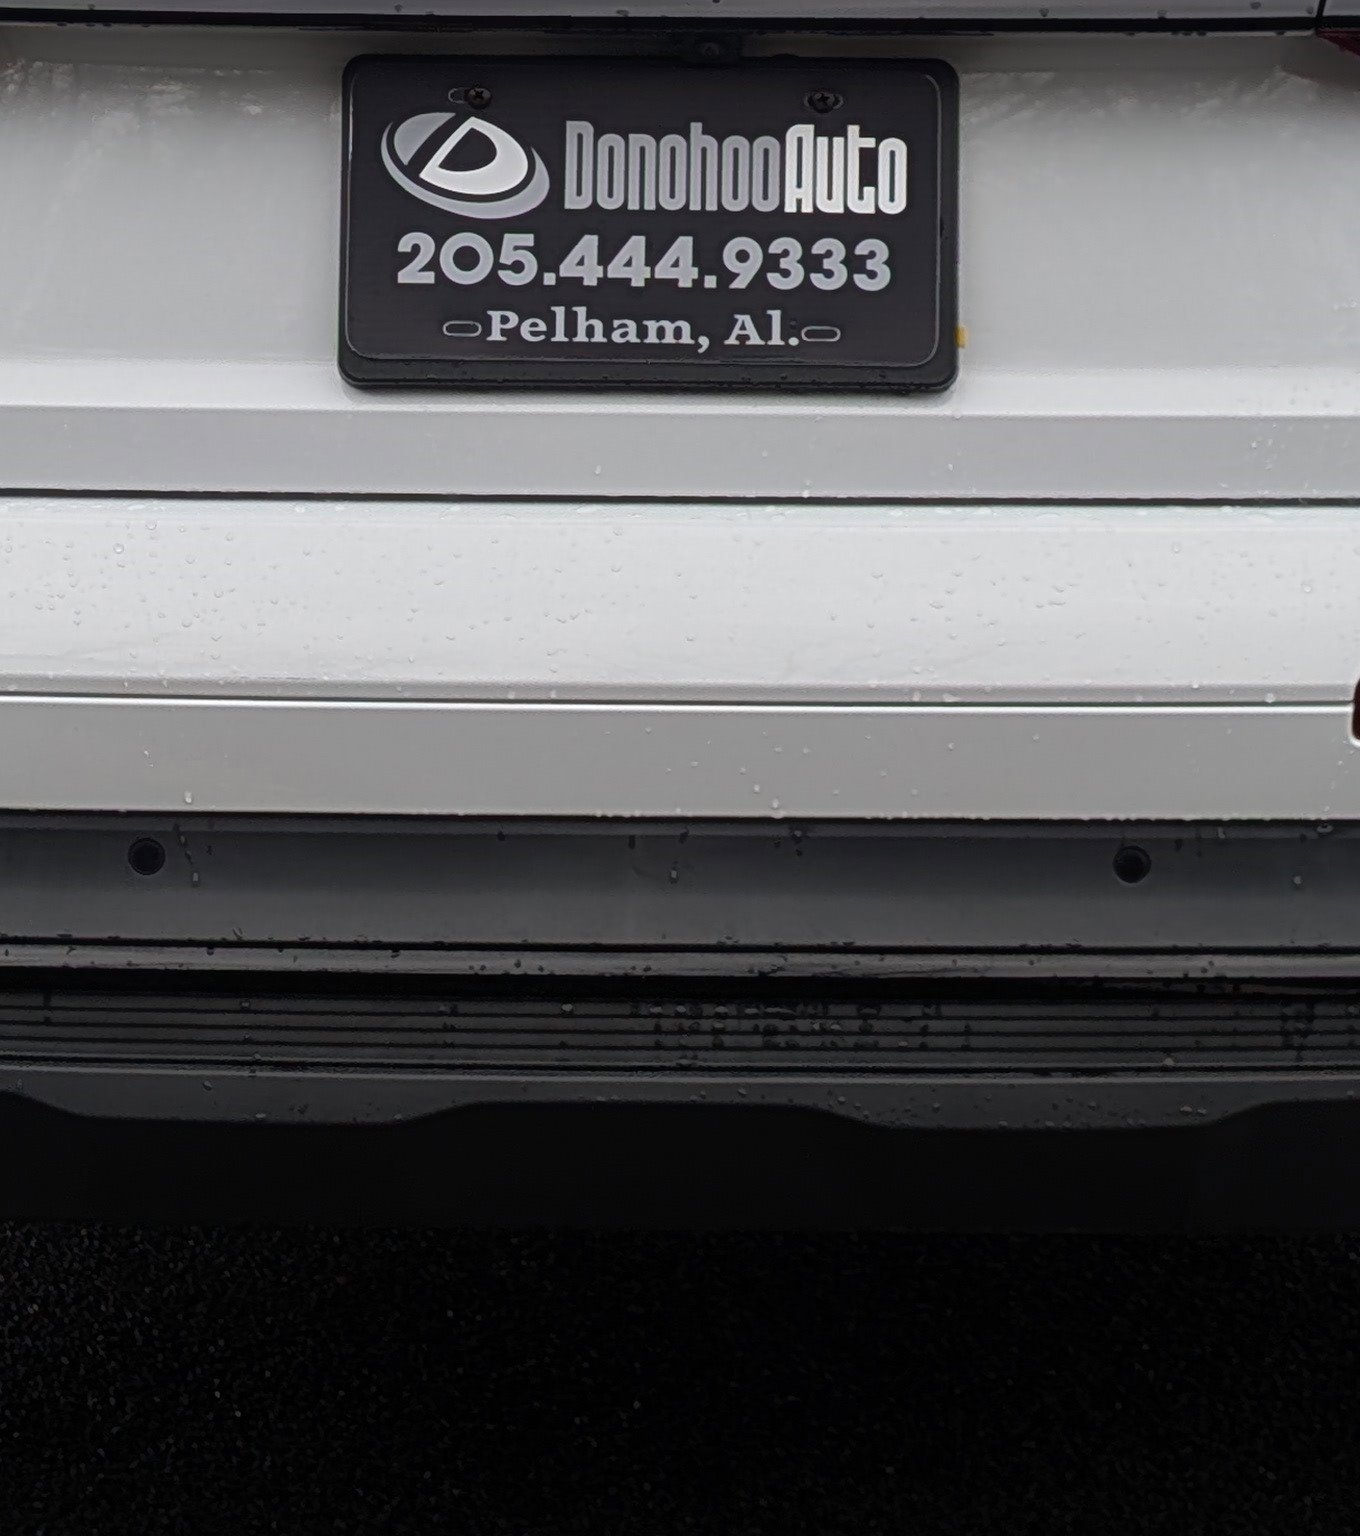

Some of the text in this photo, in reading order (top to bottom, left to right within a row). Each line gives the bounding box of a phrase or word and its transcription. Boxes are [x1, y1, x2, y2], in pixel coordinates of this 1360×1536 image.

[564, 119, 909, 215] DonohooAuto
[396, 231, 892, 292] 205.444.9333
[486, 306, 801, 353] Pelham, Al.
